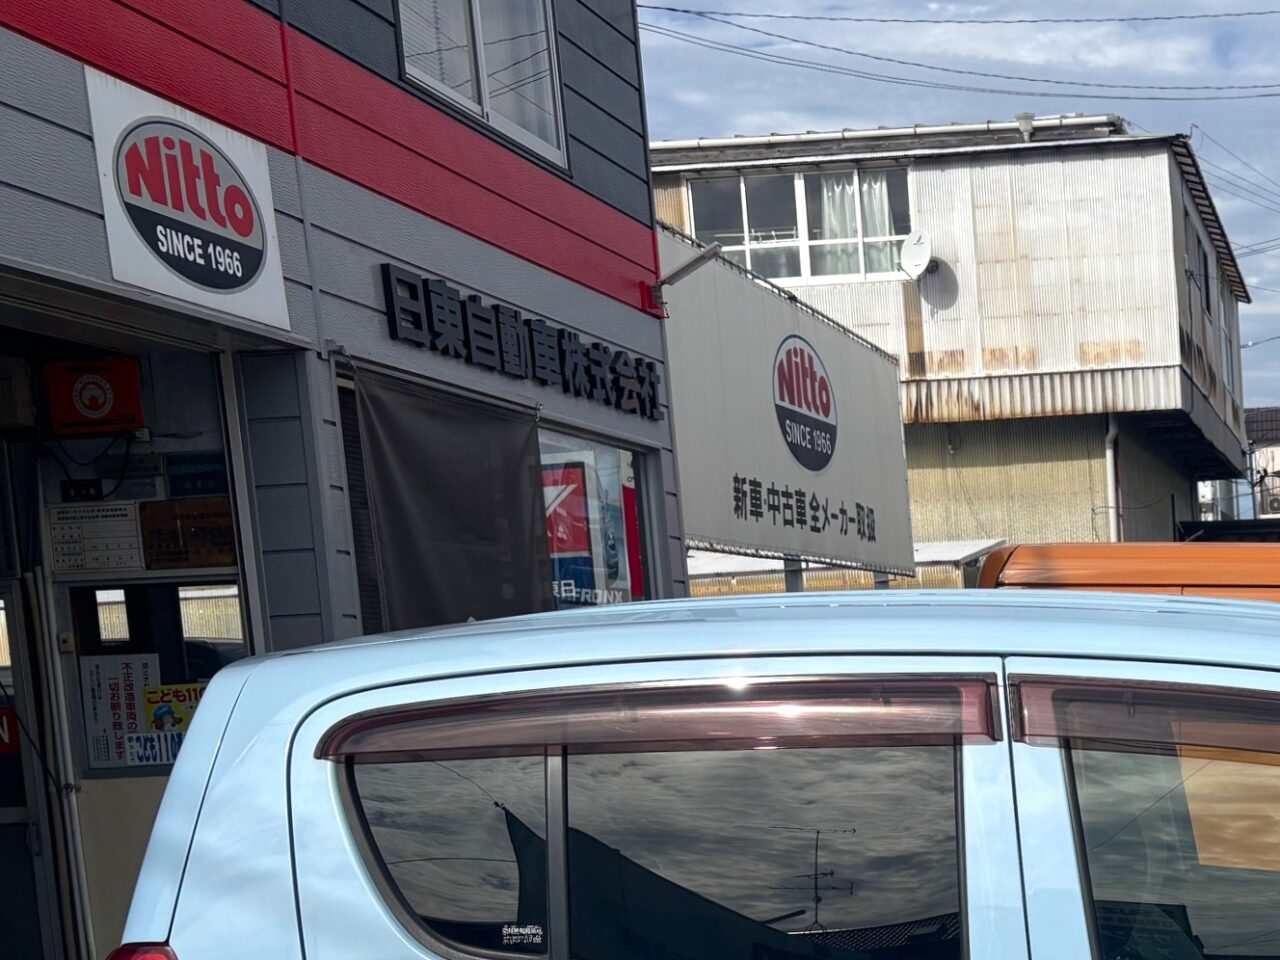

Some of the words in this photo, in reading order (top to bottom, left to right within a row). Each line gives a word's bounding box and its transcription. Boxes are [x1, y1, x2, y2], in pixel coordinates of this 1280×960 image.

[125, 136, 254, 238] Nitto
[156, 225, 205, 265] SINCE
[208, 243, 242, 277] 1966
[381, 263, 664, 421] 日東自動車株式会社
[777, 346, 831, 418] Nitto
[785, 419, 812, 449] SINCE
[813, 429, 832, 455] 1966
[121, 662, 138, 732] 不正改造車両の
